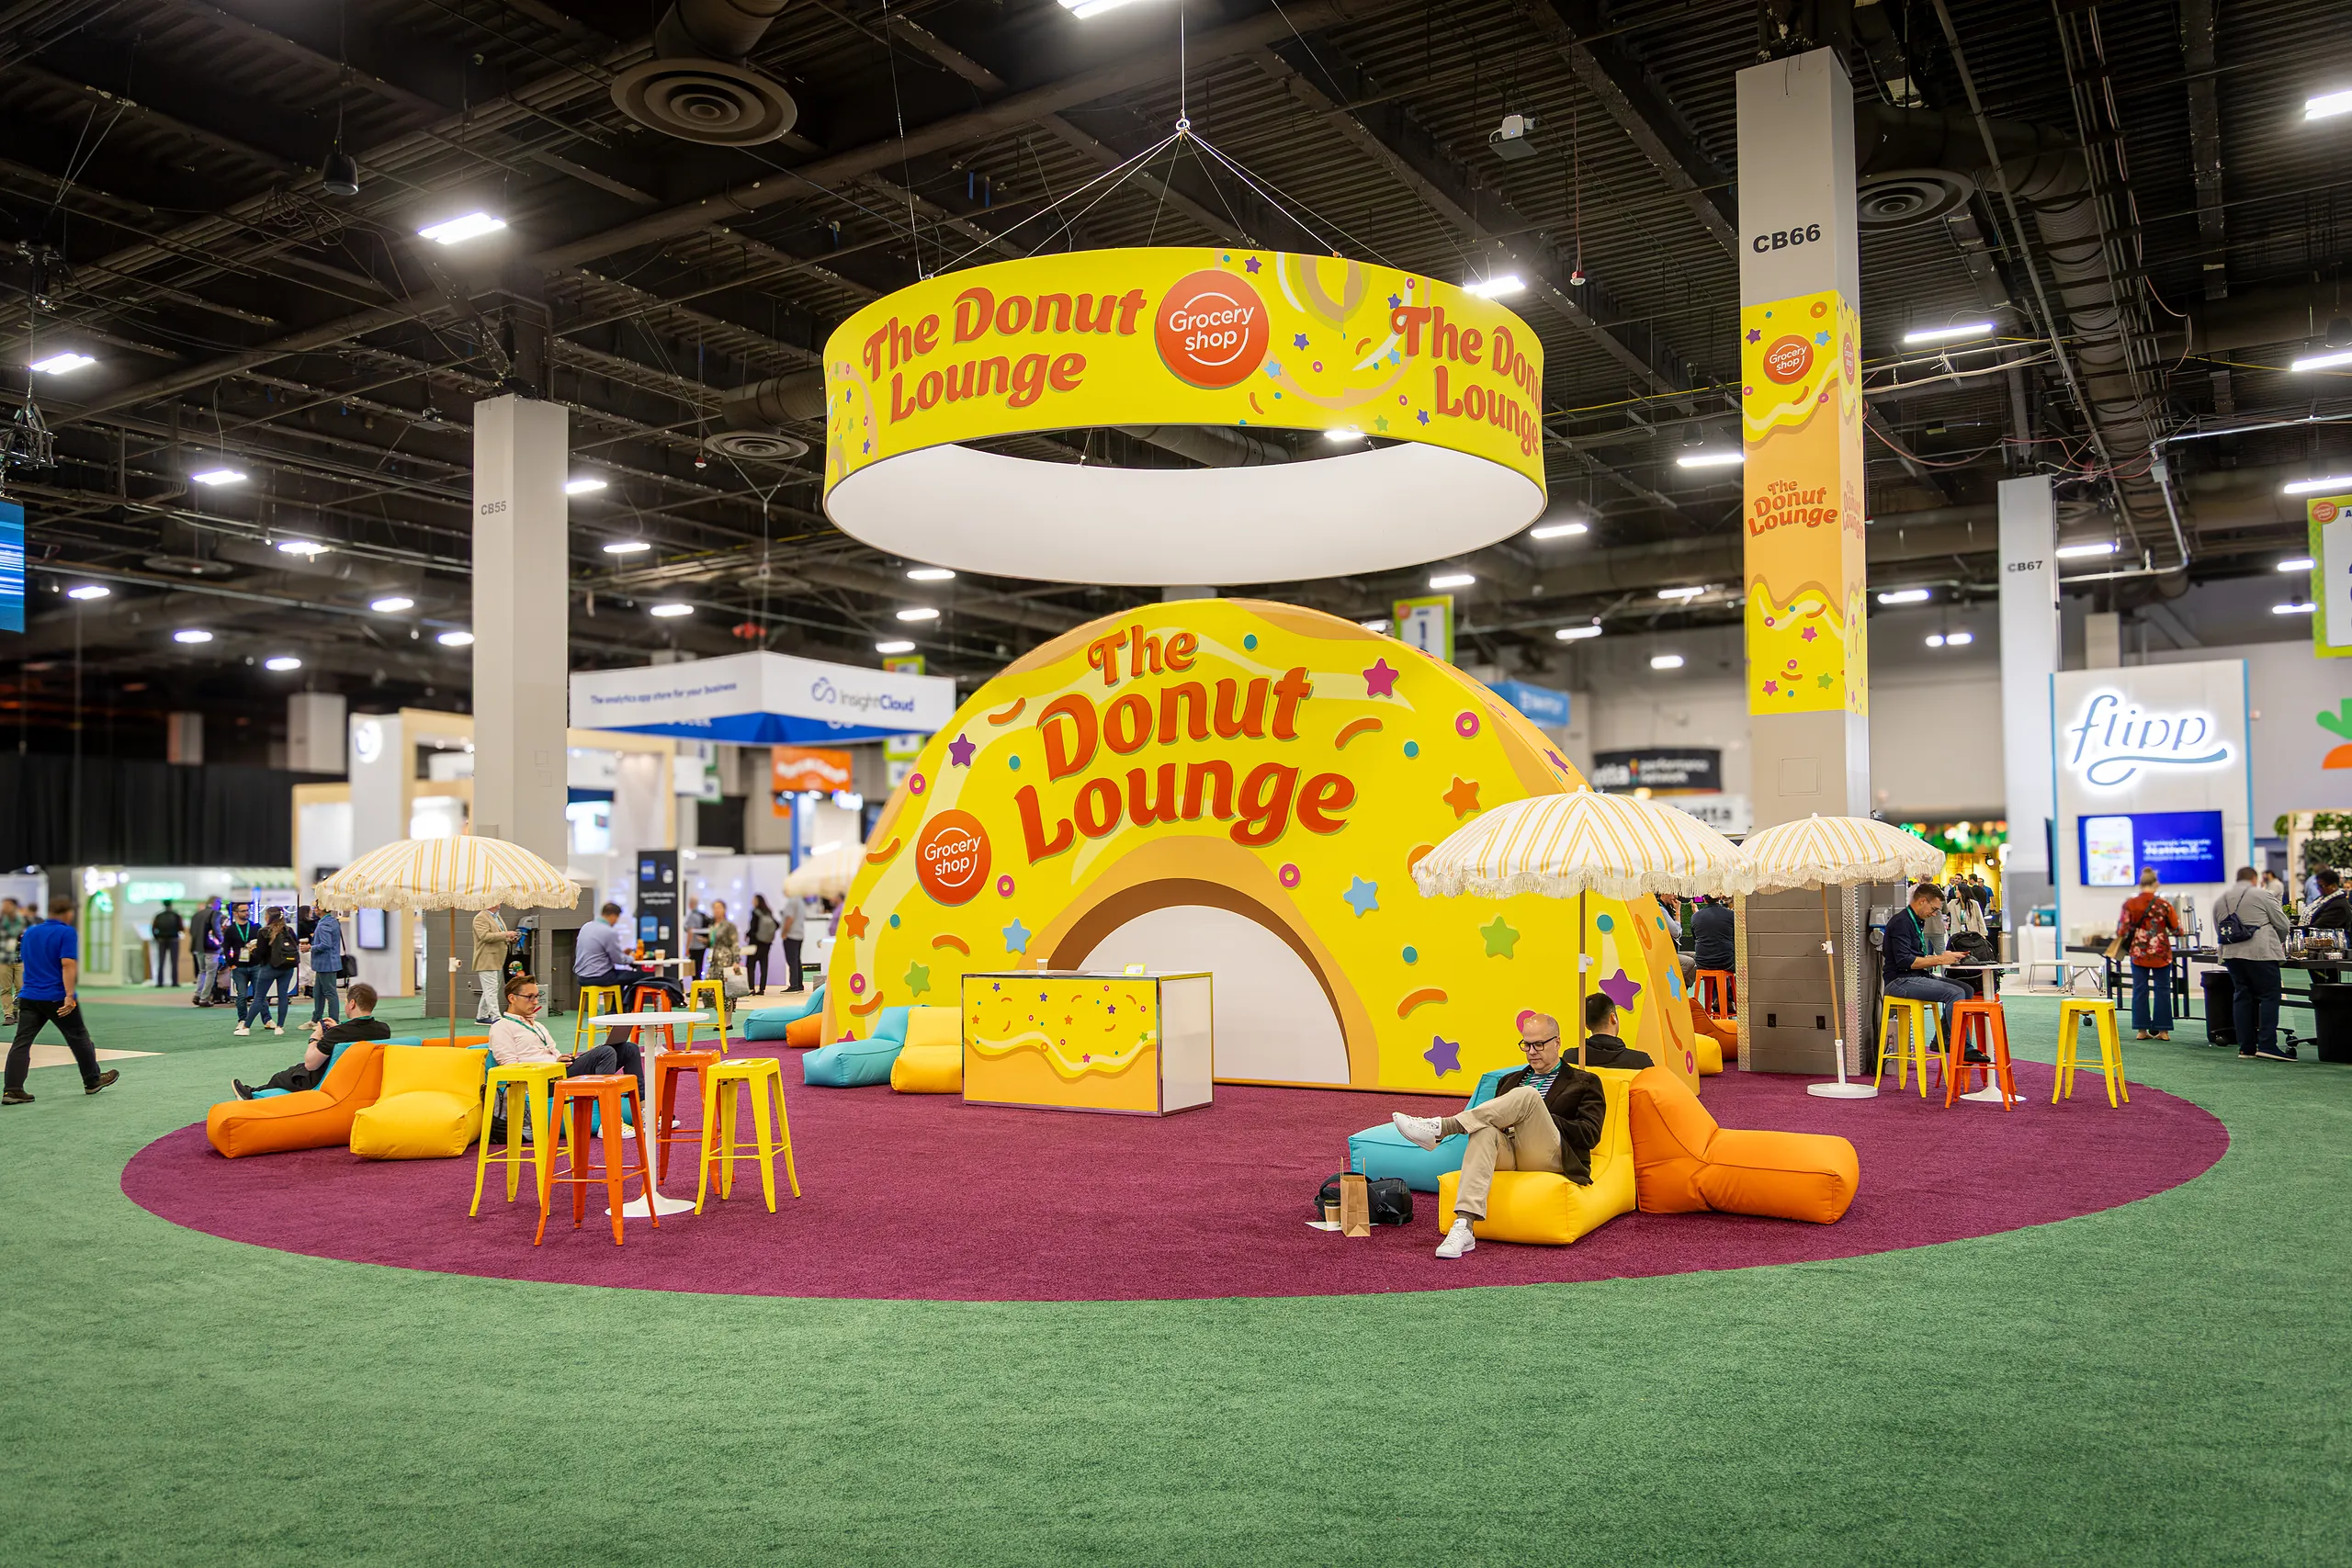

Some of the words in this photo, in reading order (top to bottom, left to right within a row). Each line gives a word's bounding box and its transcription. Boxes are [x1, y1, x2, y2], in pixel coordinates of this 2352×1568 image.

[1752, 223, 1821, 254] CB66
[1169, 306, 1255, 333] Grocery
[863, 313, 940, 383] The
[952, 287, 1148, 345] Donut
[1184, 330, 1238, 351] shop
[1390, 306, 1484, 366] The
[1492, 326, 1542, 417] Donu
[1769, 345, 1807, 365] Grocery
[1776, 356, 1800, 372] shop
[889, 352, 1087, 426] Lounge
[1433, 365, 1539, 457] Lounge
[1768, 479, 1798, 496] The
[481, 501, 506, 515] CB55
[1753, 486, 1827, 519] Donut
[1747, 506, 1838, 537] Lounge
[2007, 560, 2043, 573] CB67
[1088, 625, 1199, 688] The
[673, 689, 684, 698] for
[704, 682, 737, 694] business
[840, 688, 915, 713] InsightCloud
[1036, 666, 1314, 784] Donut
[2071, 694, 2228, 786] flipp
[1013, 759, 1358, 866] Lounge
[924, 836, 981, 861] Grocery
[935, 857, 970, 876] shop
